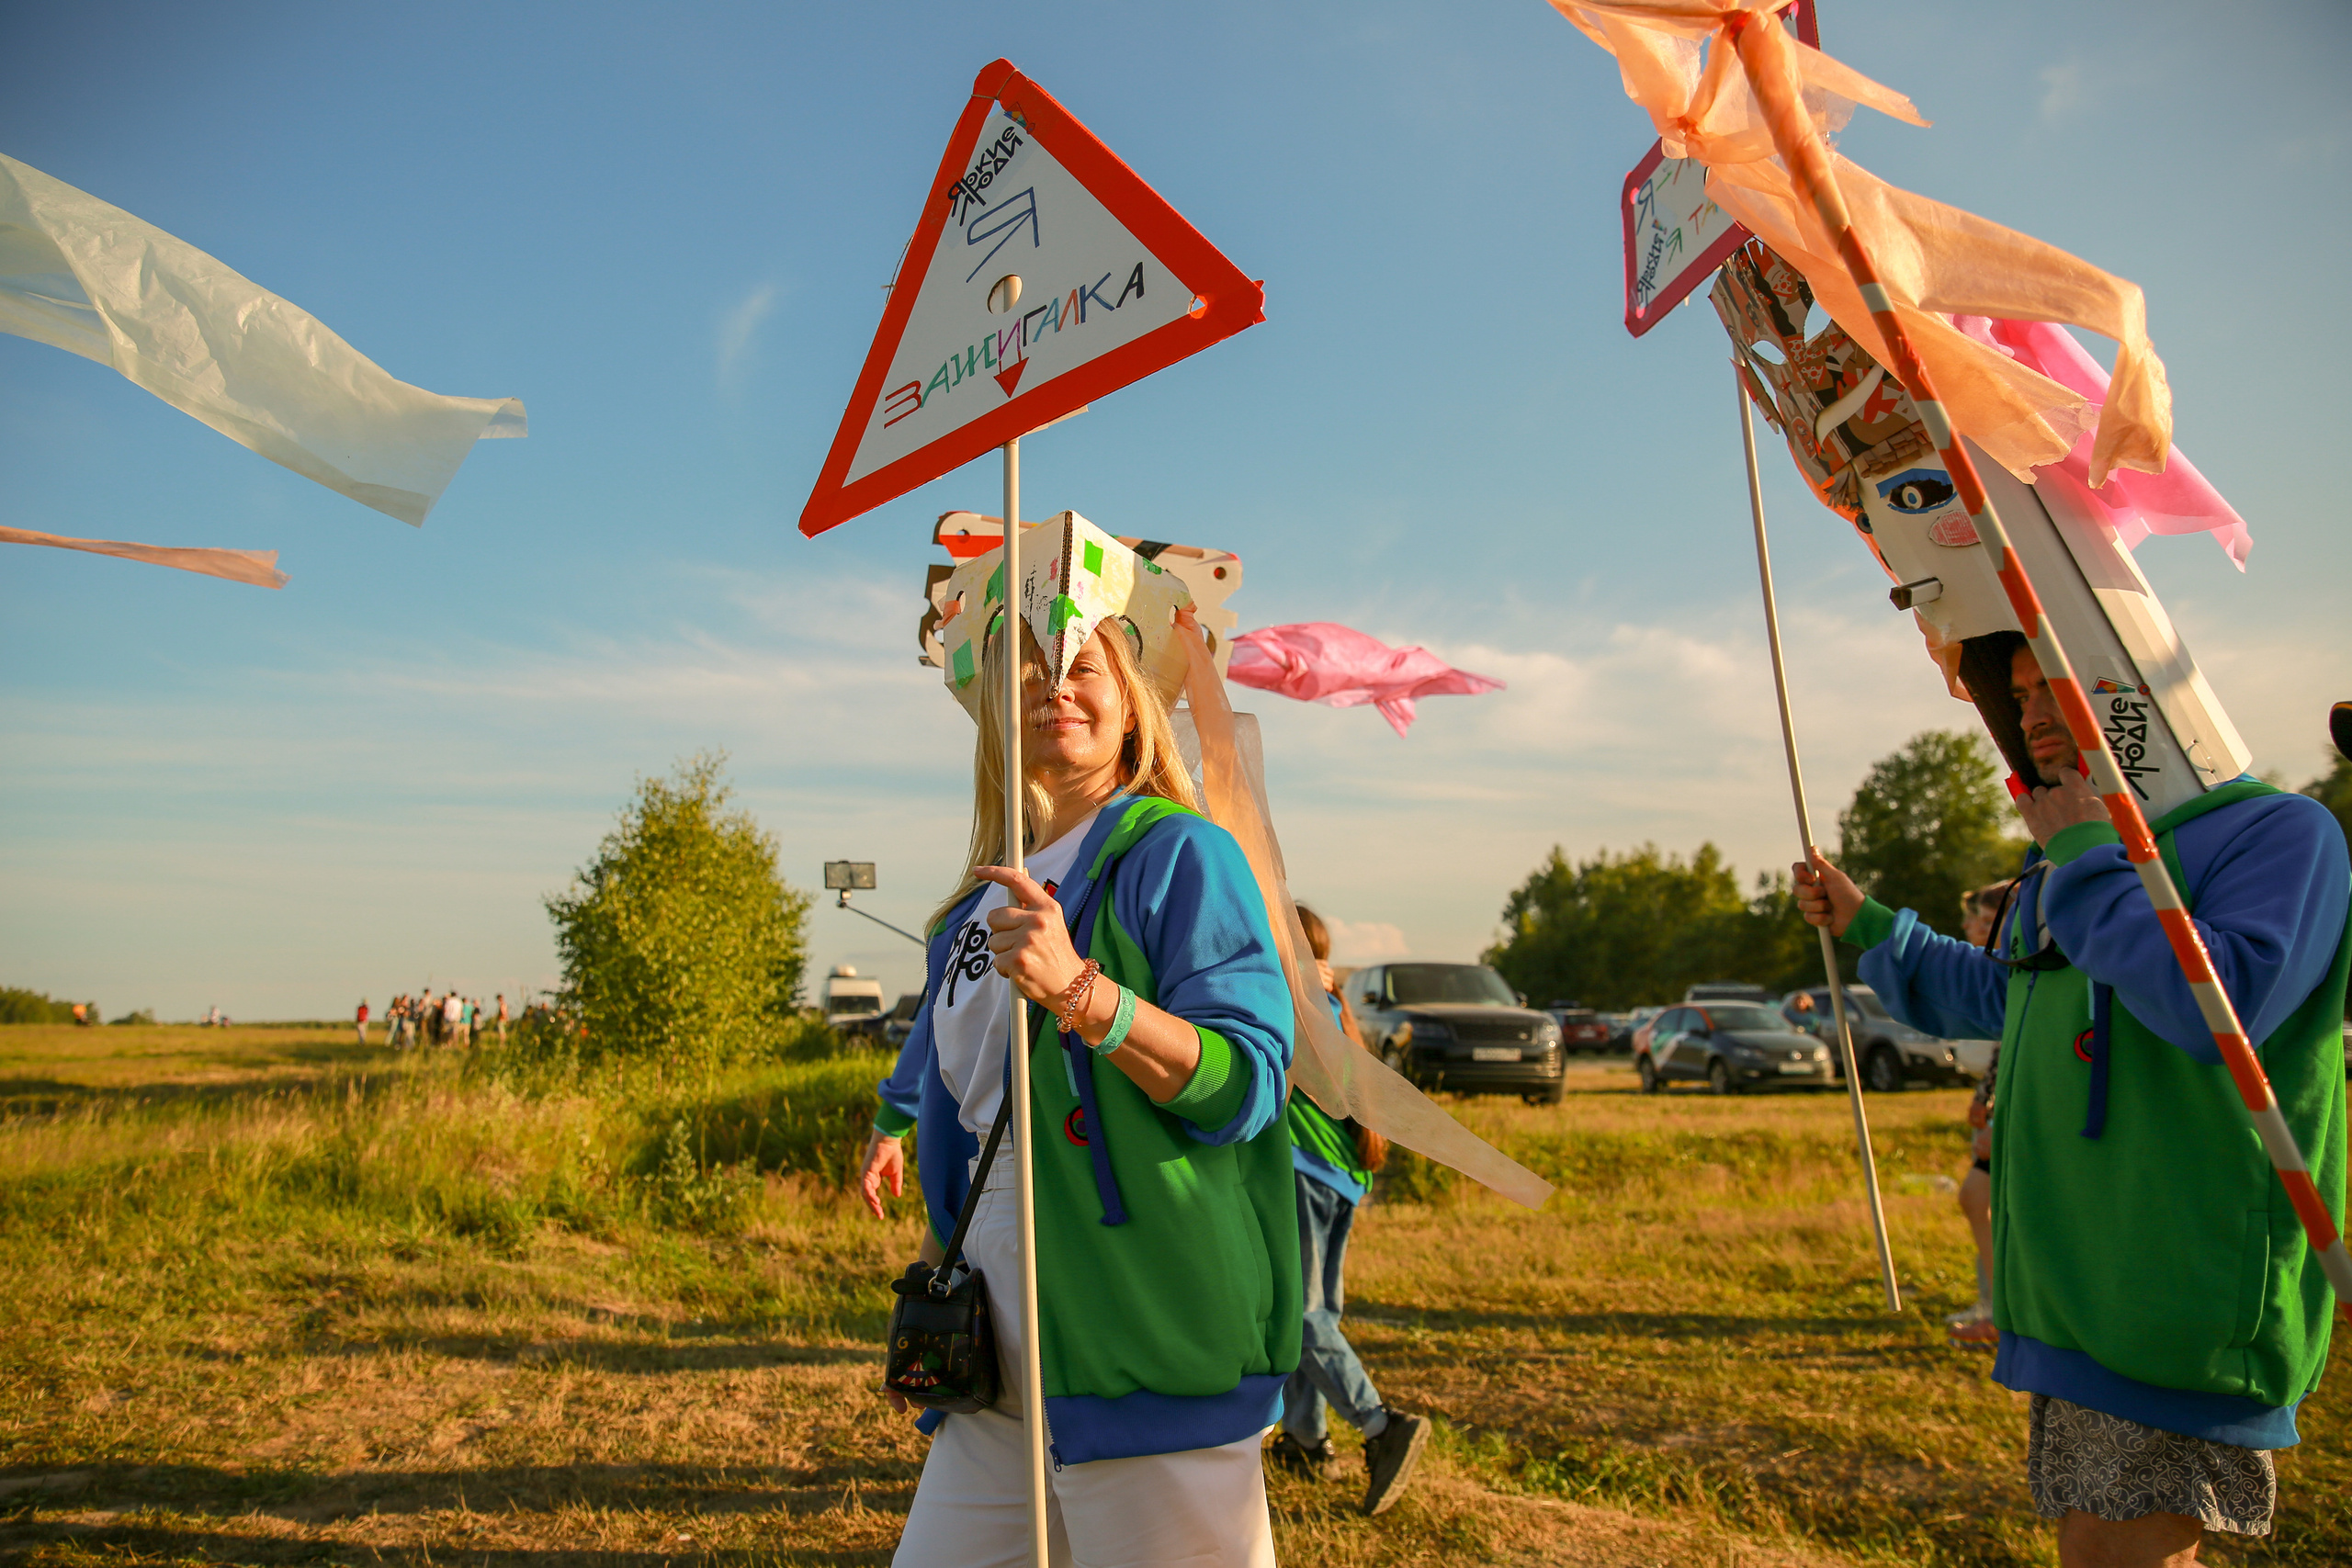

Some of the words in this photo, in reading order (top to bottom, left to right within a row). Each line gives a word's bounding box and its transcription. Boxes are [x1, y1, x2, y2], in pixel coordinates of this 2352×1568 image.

[966, 186, 1040, 283] Я
[1637, 178, 1655, 236] Я
[1666, 227, 1683, 265] Я
[883, 261, 1145, 430] ЗАЖИГАЛКА
